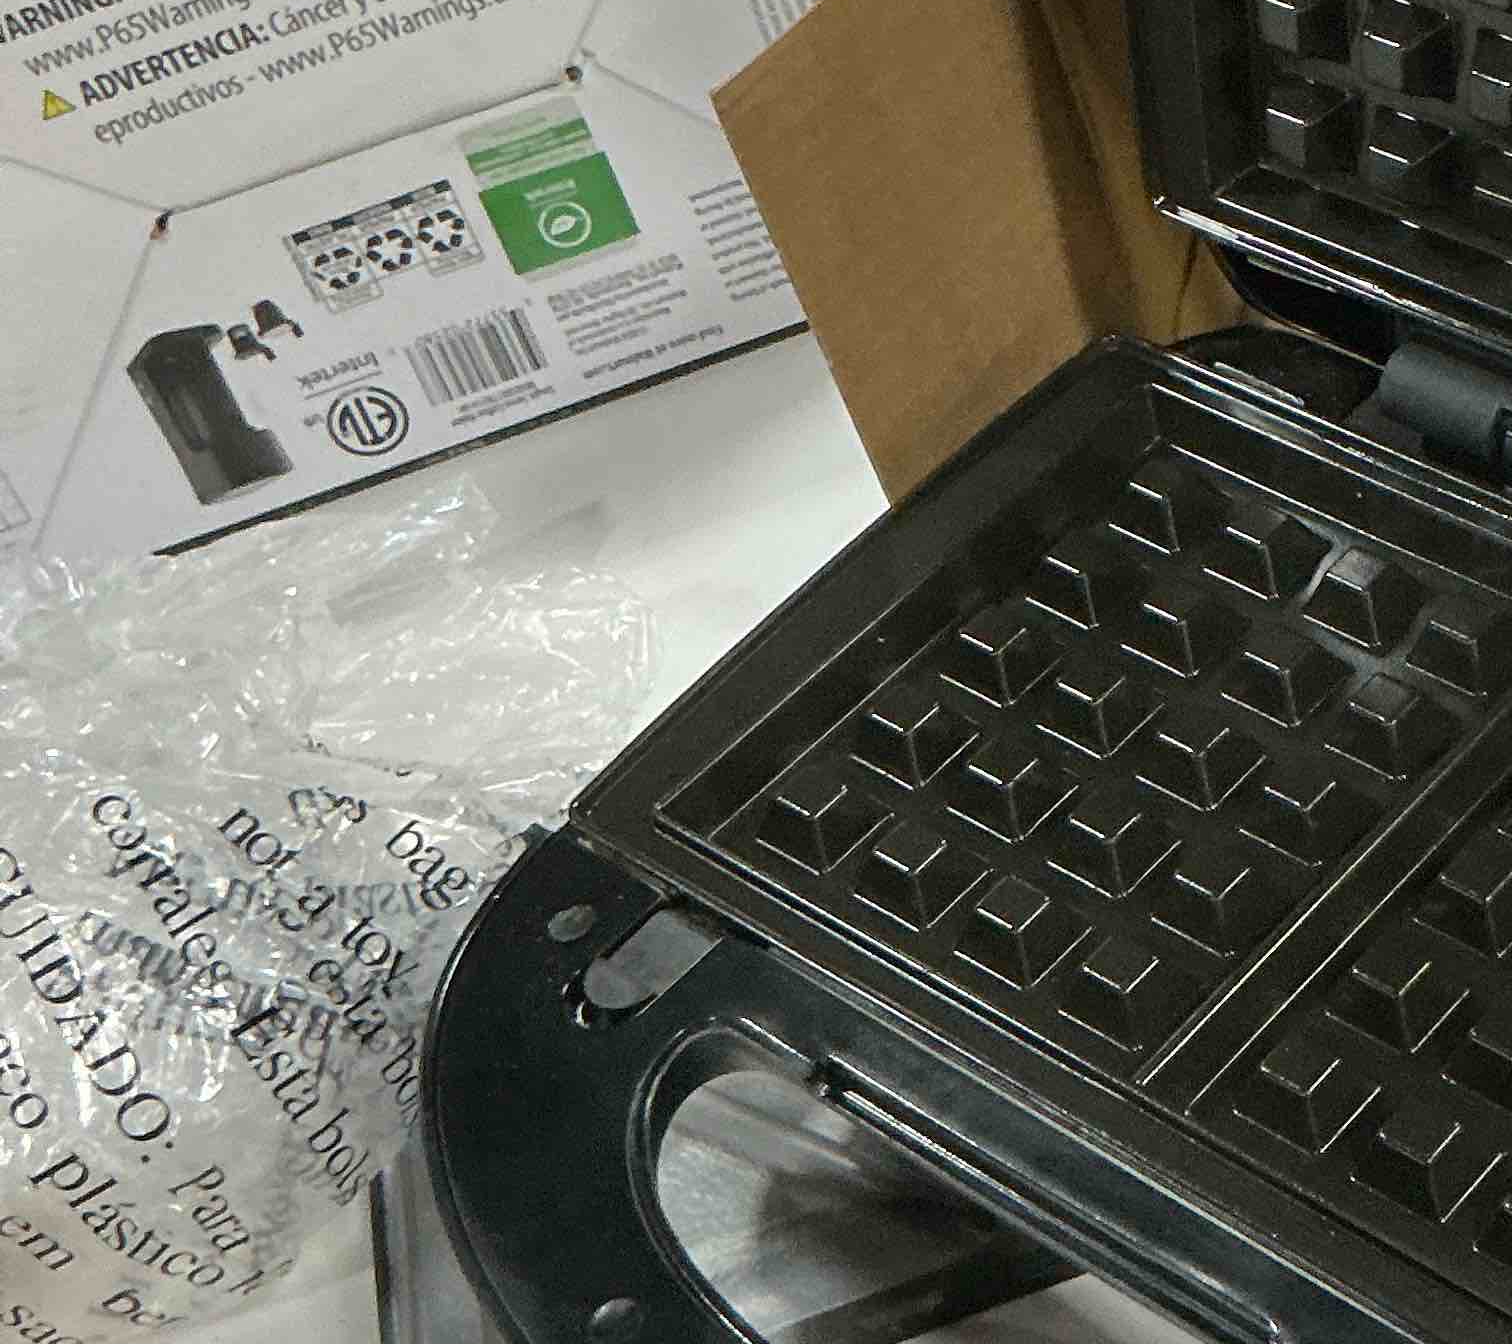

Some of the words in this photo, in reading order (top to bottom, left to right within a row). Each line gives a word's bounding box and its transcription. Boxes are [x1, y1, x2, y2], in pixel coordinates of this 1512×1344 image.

[79, 22, 271, 108] ADVERTENCIA:
[296, 351, 380, 392] Intertek
[386, 819, 470, 910] bag
[168, 1165, 252, 1256] Para
